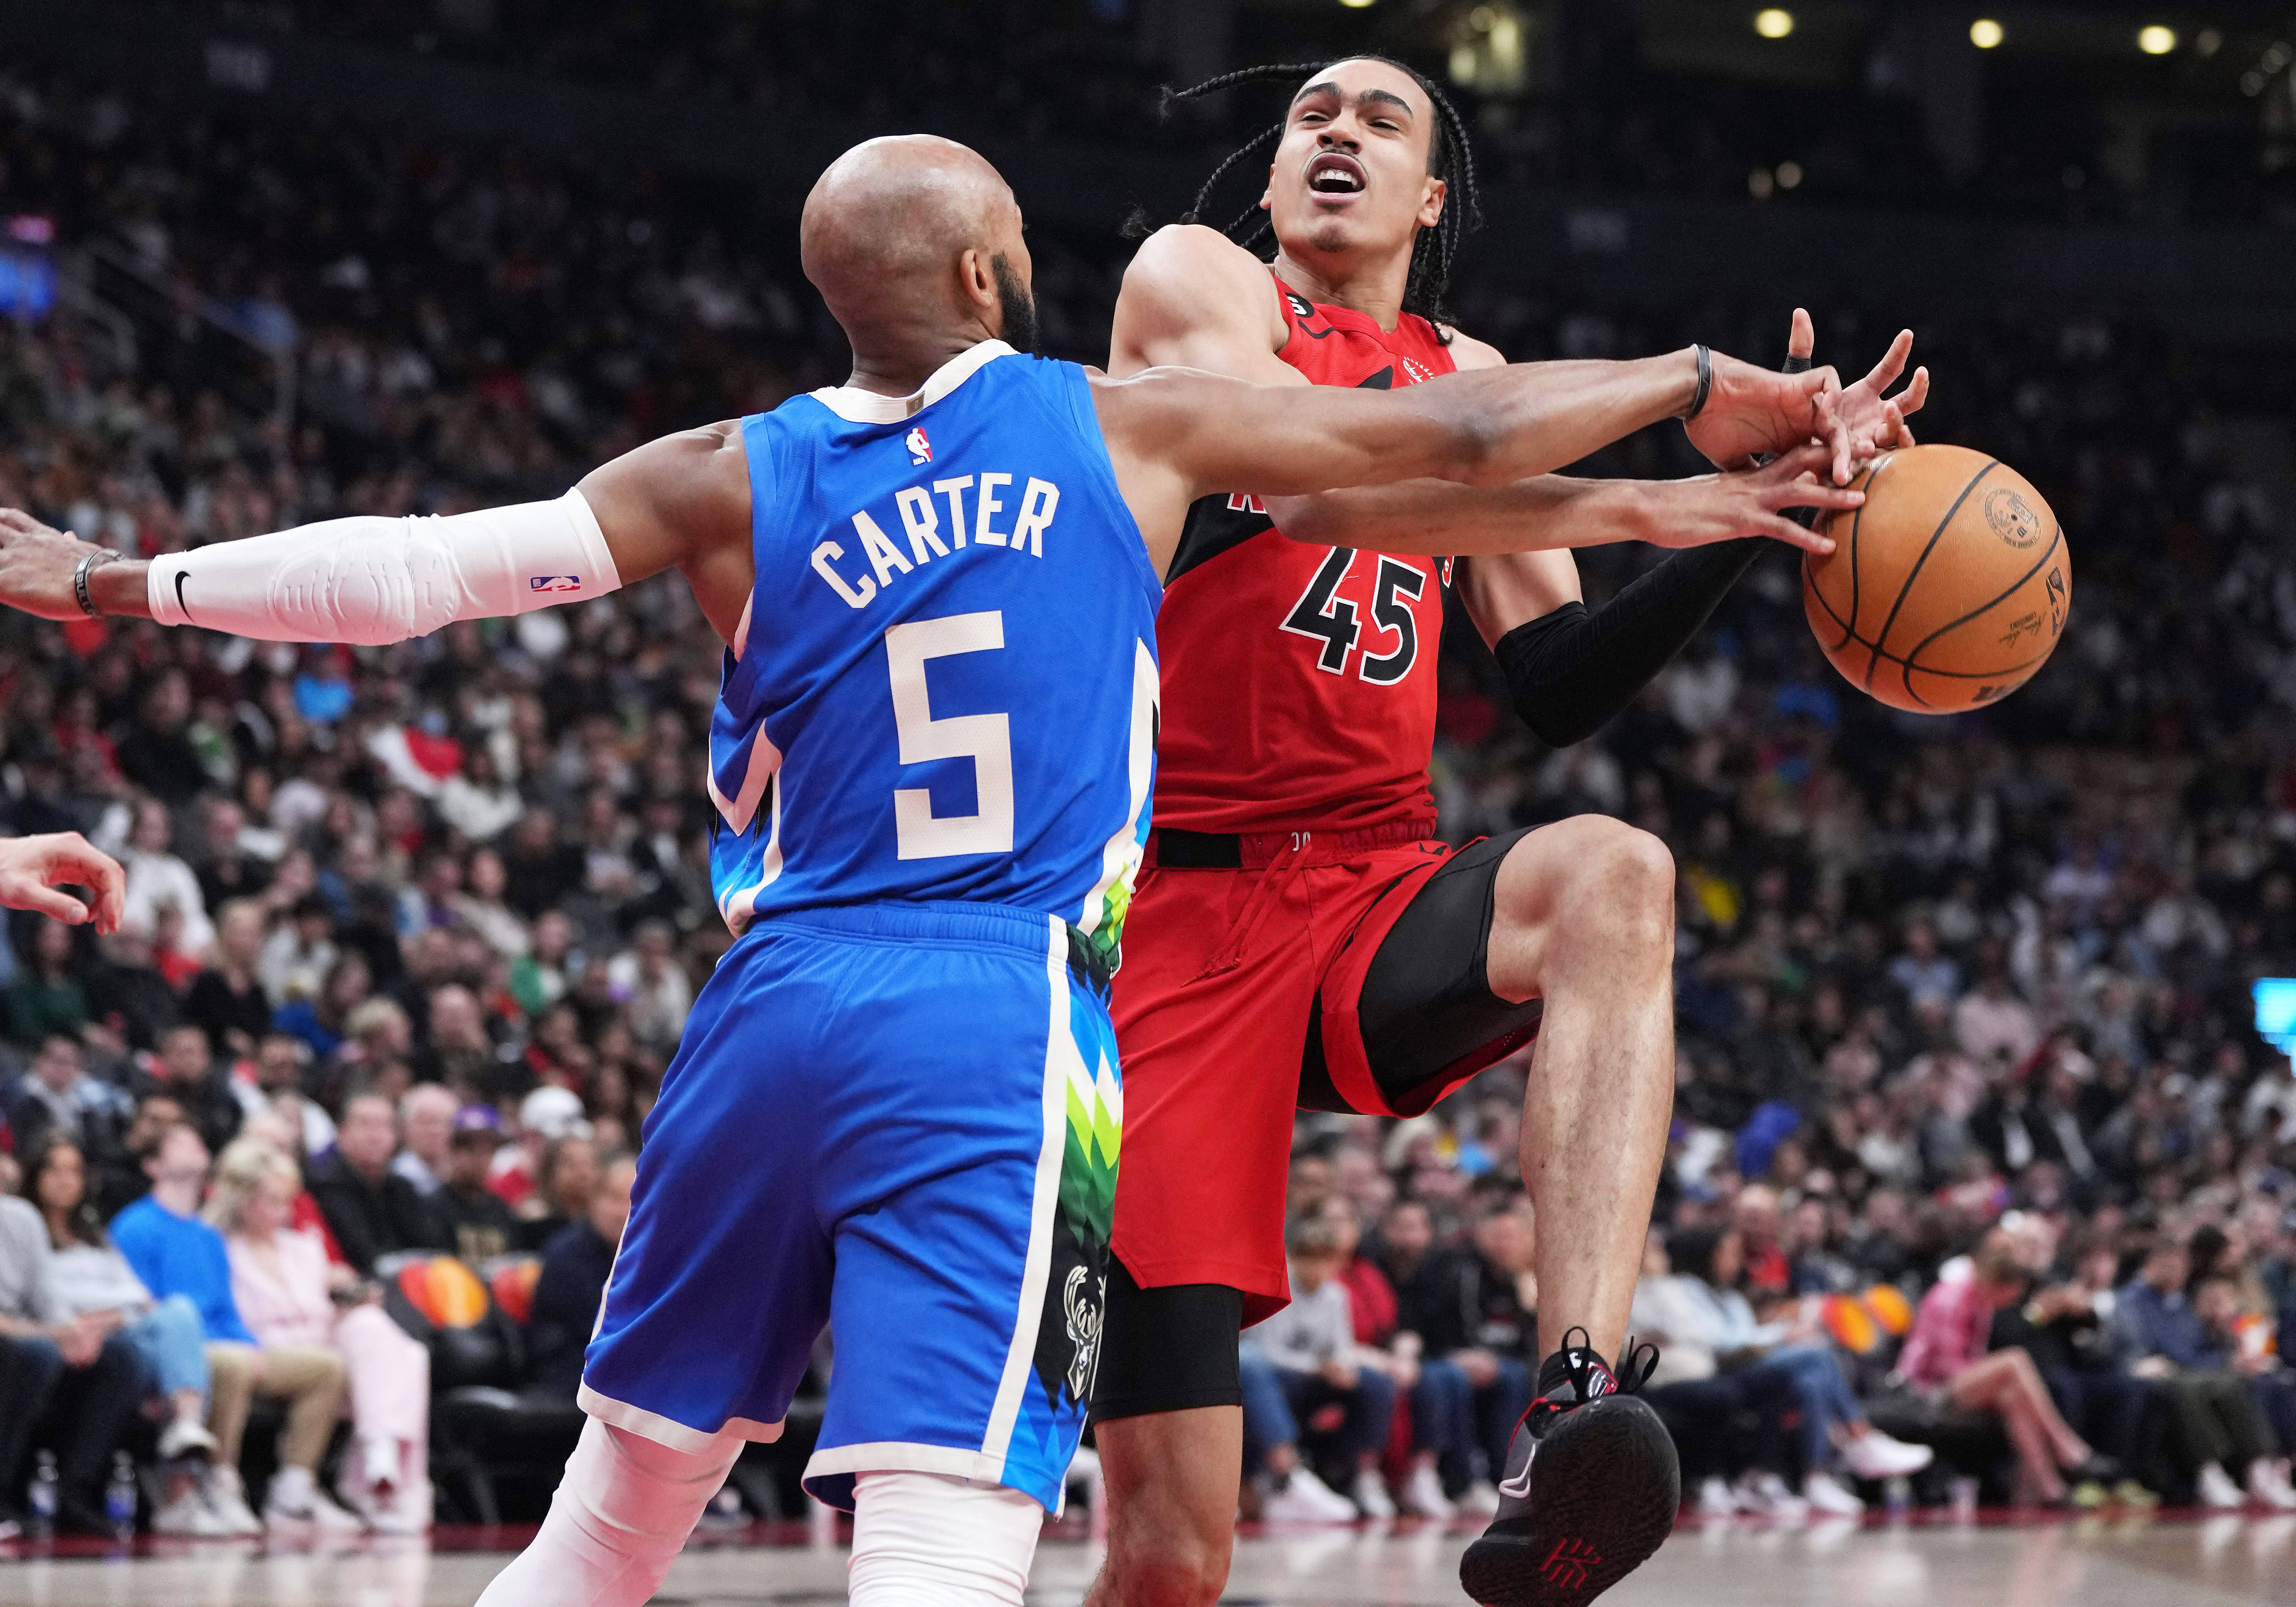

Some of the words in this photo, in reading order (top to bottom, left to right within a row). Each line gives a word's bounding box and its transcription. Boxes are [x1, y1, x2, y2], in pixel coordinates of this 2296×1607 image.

[811, 472, 1060, 609] CARTER
[1278, 546, 1427, 686] 45
[885, 610, 1014, 860] 5
